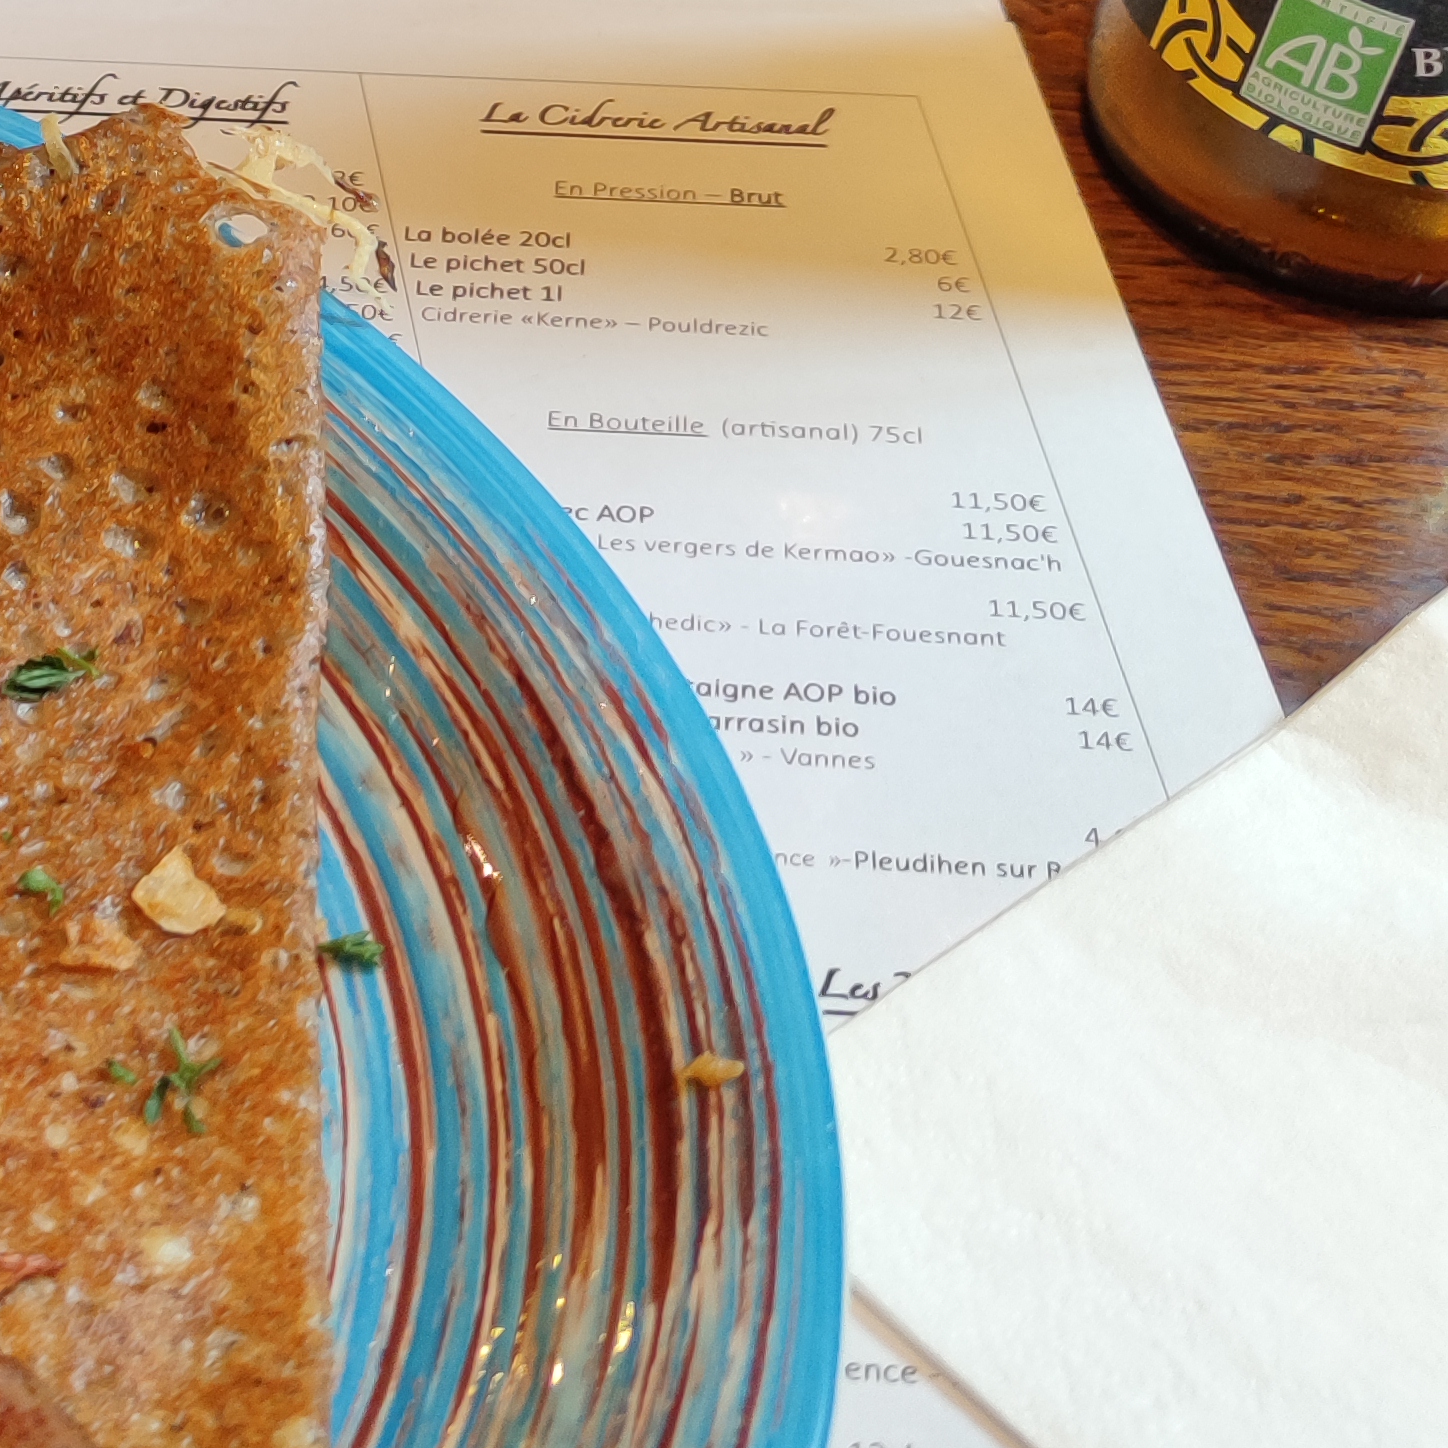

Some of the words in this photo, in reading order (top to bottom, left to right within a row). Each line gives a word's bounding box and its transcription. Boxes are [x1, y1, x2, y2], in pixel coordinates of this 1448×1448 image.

[1264, 33, 1362, 101] AB
[117, 89, 146, 105] et
[158, 80, 300, 130] Digestifs
[1252, 69, 1366, 127] AGRICULTURE
[480, 103, 529, 123] La
[539, 99, 666, 129] Cidrerie
[673, 108, 835, 135] Artisanal
[554, 181, 585, 200] En
[594, 183, 696, 204] Pression
[730, 188, 786, 208] Brut
[405, 226, 431, 242] La
[442, 227, 510, 245] bolée
[519, 231, 570, 248] 20cl
[884, 247, 957, 265] 2,80€
[411, 253, 437, 269] Le
[446, 255, 524, 273] pichet
[533, 258, 584, 275] 50cl
[938, 277, 969, 292] 6€
[417, 280, 443, 296] Le
[452, 282, 531, 301] pichet
[542, 285, 561, 301] 1l
[935, 304, 981, 320] 12€
[422, 307, 512, 324] Cidrerie
[649, 317, 768, 336] Pouldrezic
[548, 411, 580, 432] En
[588, 413, 708, 437] Bouteille
[870, 426, 922, 444] 75cl
[952, 492, 1045, 512] 11,50€
[596, 505, 654, 523] AOP
[964, 523, 1057, 543] 11,50€
[599, 534, 635, 551] Les
[645, 541, 735, 558] vergers
[746, 541, 773, 558] de
[990, 600, 1085, 621] 11,50€
[760, 619, 785, 635] La
[797, 620, 1005, 646] Forêt-Fouesnant
[784, 683, 843, 702] AOP
[854, 684, 896, 705] bio
[1066, 697, 1118, 717] 14€
[817, 715, 858, 737] bio
[1079, 731, 1132, 751] 14€
[781, 748, 875, 769] Vannes
